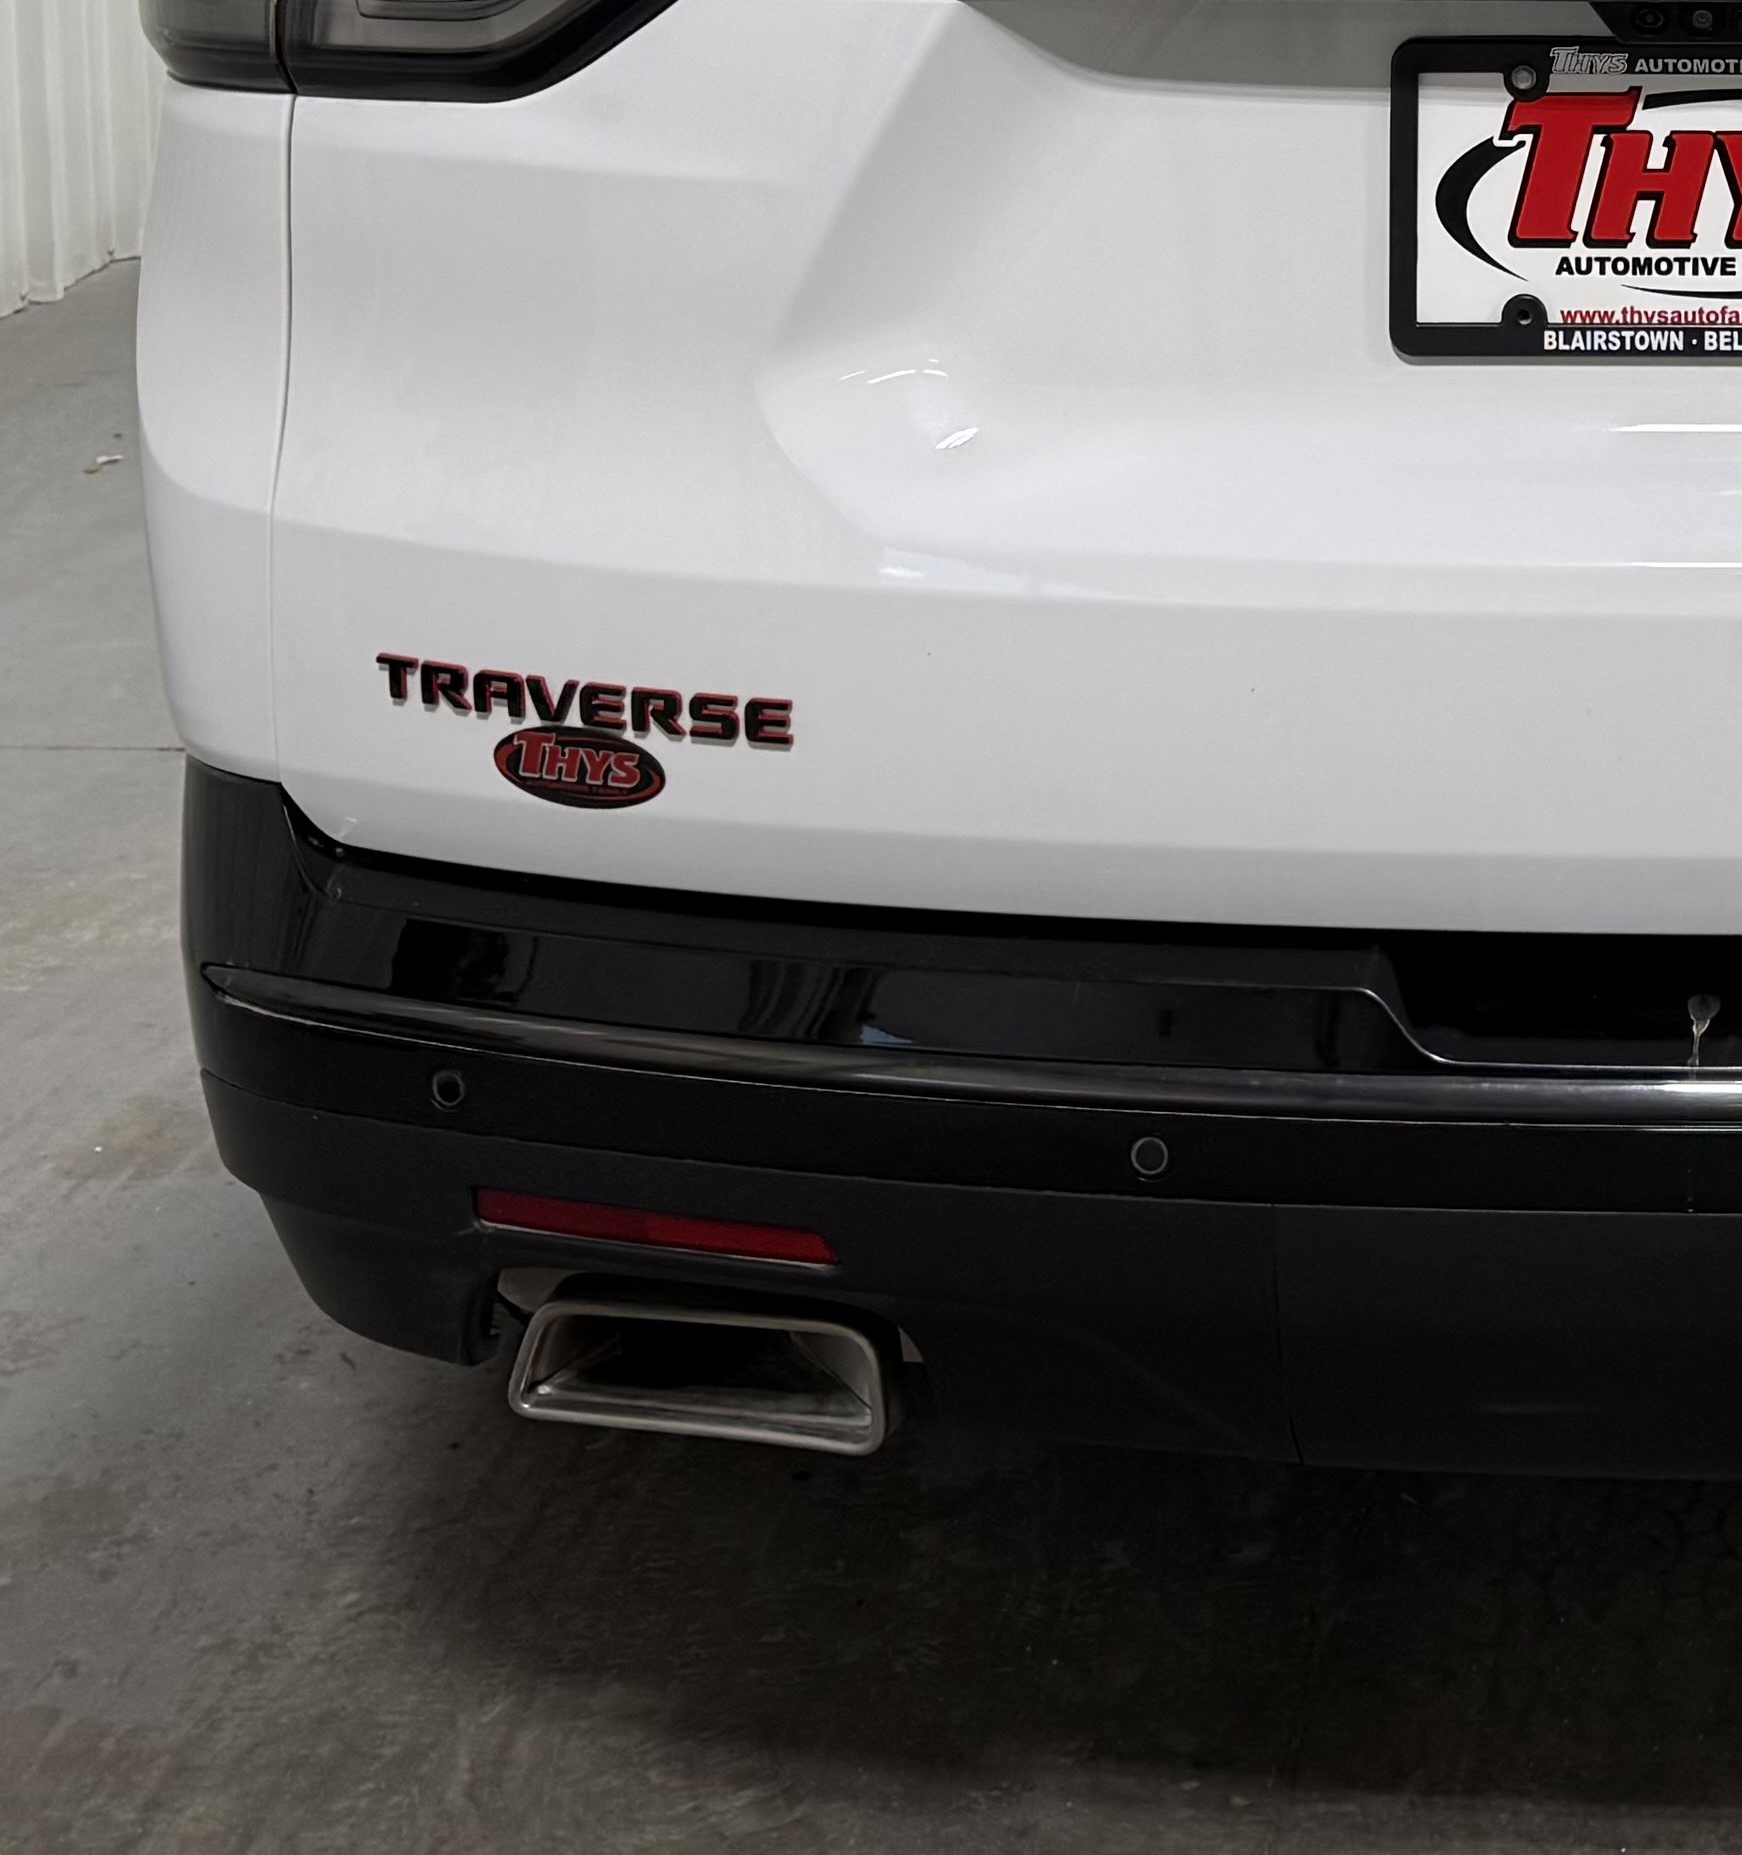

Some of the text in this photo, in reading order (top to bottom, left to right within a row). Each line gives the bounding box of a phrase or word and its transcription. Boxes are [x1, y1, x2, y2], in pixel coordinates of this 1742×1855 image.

[1550, 46, 1628, 74] THYS
[1555, 256, 1737, 277] AUTOMOTIVE
[1543, 330, 1684, 351] BLAIRSTOWN
[376, 652, 793, 748] TRAVERSE
[514, 731, 641, 788] THYS
